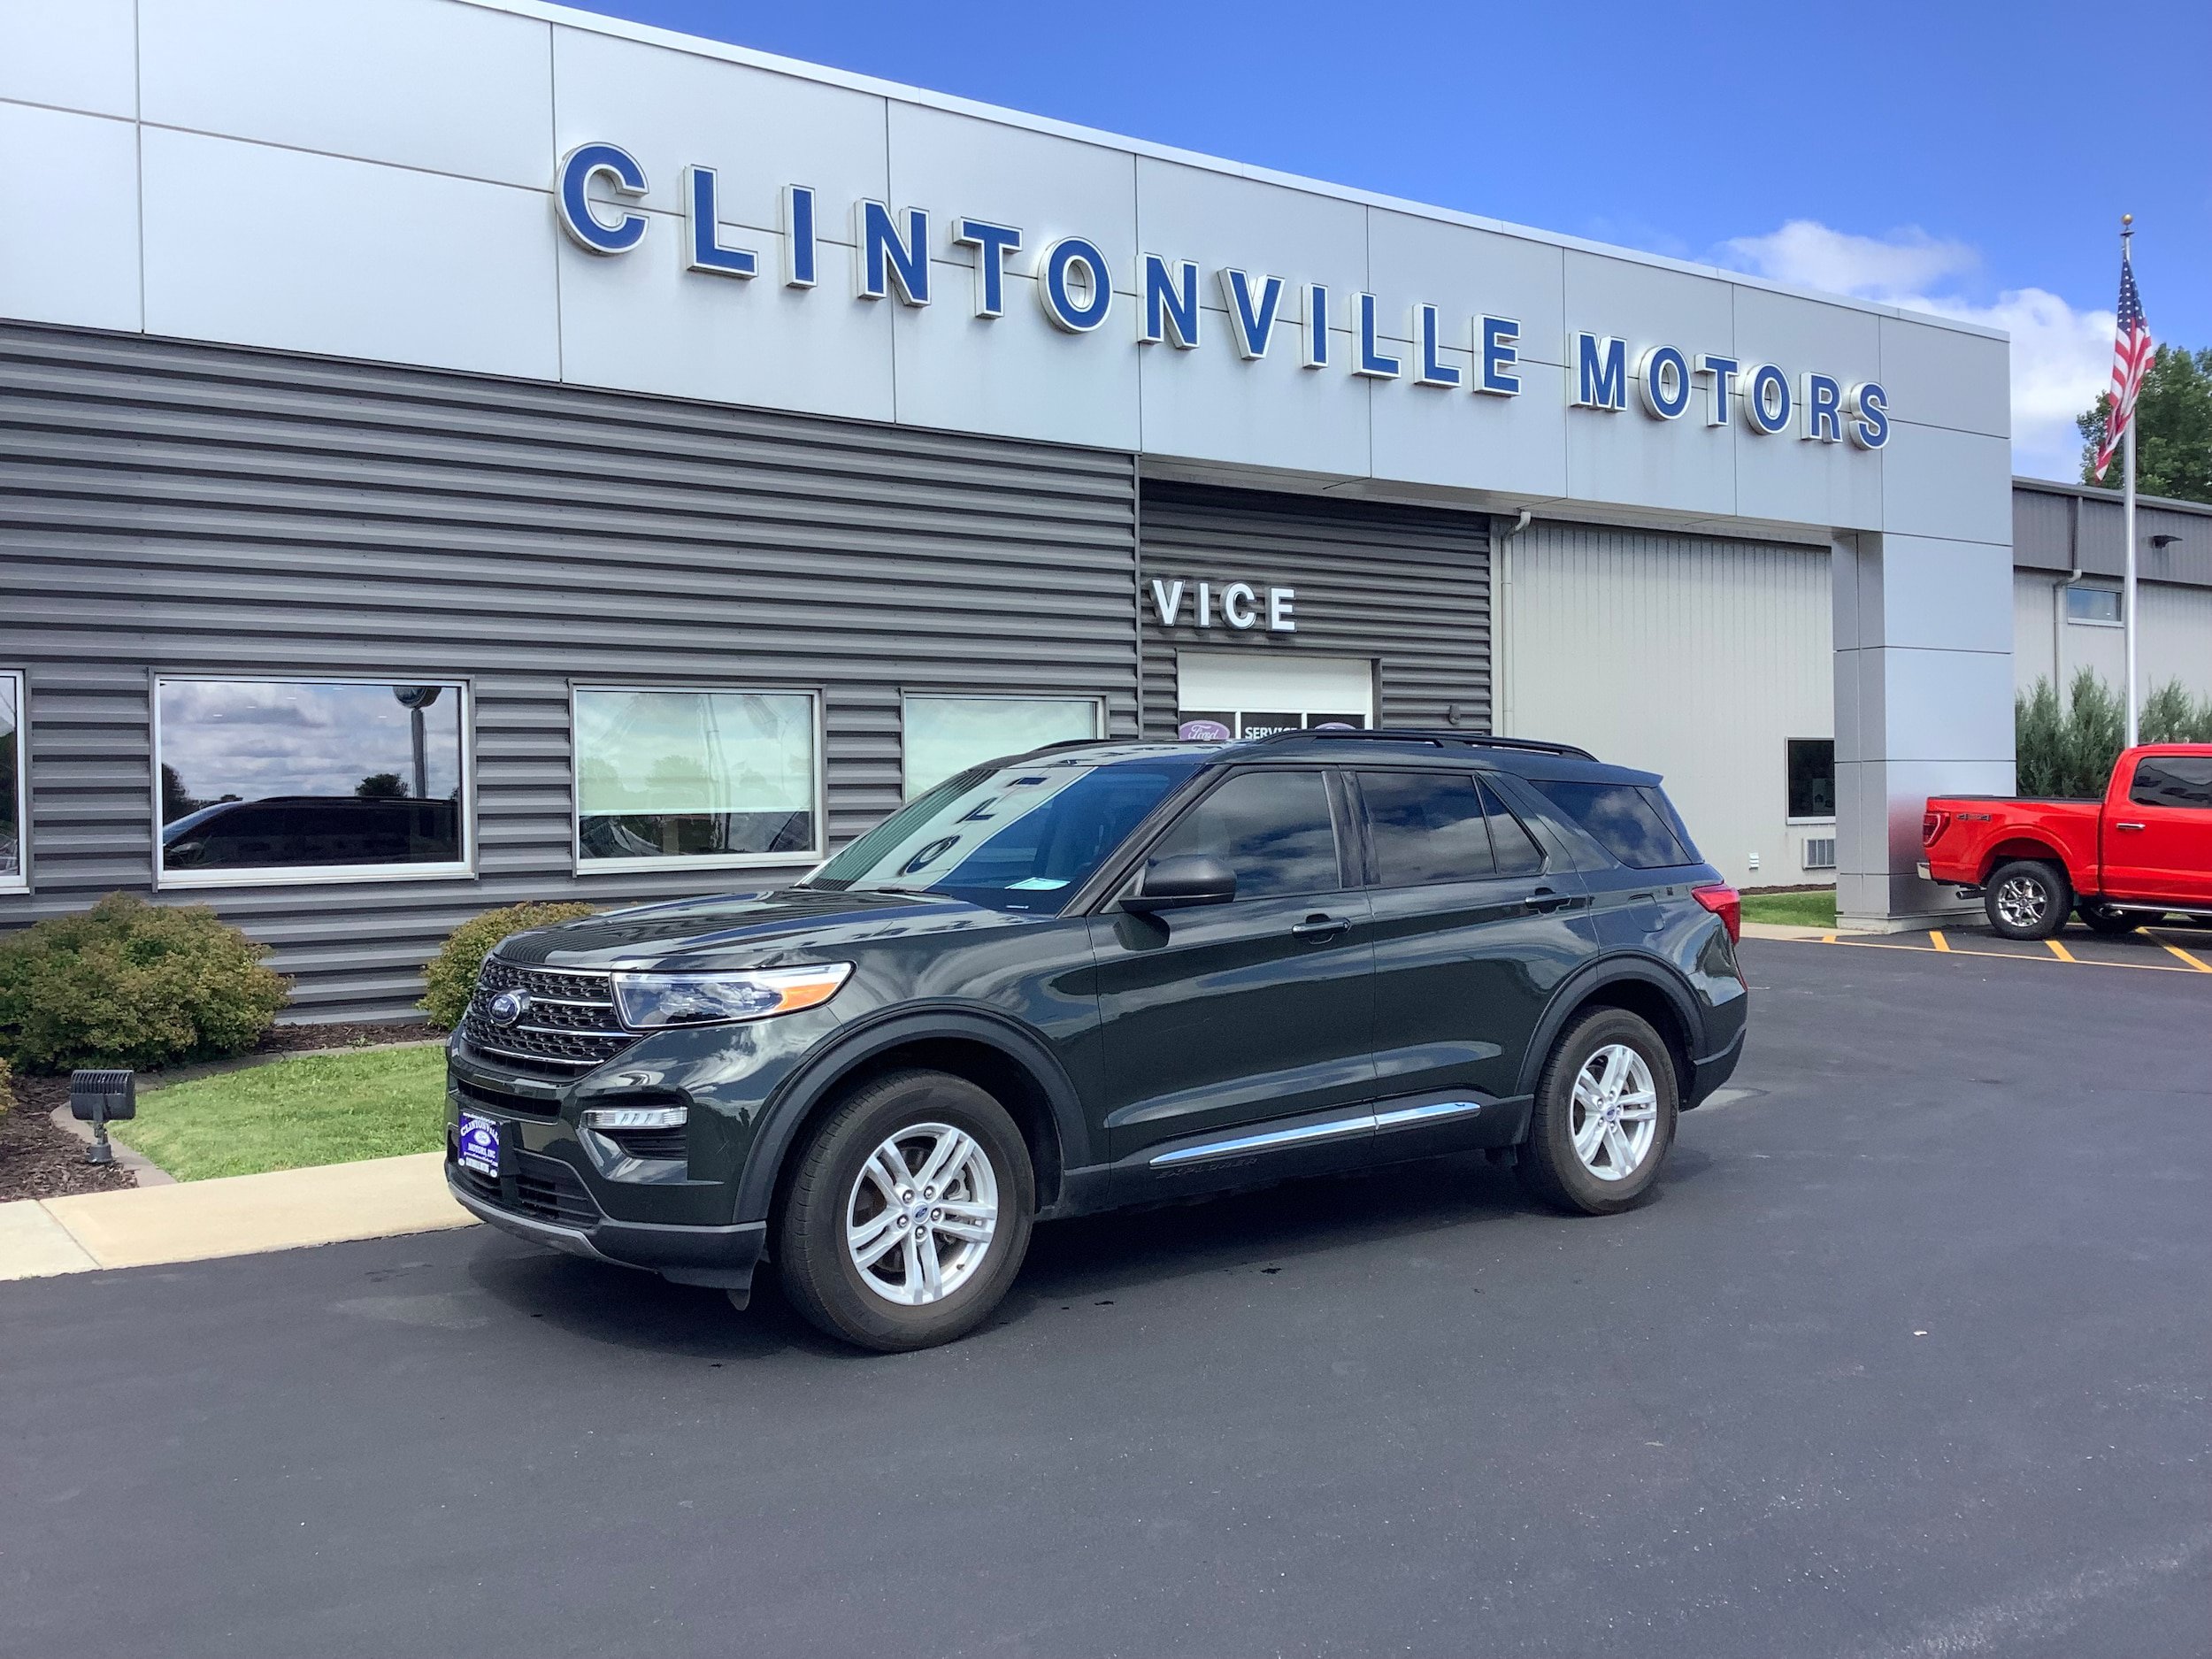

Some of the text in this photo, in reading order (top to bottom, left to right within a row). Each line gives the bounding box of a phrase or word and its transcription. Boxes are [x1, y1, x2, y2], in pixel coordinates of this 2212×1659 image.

[555, 142, 1891, 450] CLINTONVILLE MOTORS
[1151, 579, 1297, 632] VICE
[1187, 724, 1219, 740] Ford
[1244, 726, 1298, 740] SERV
